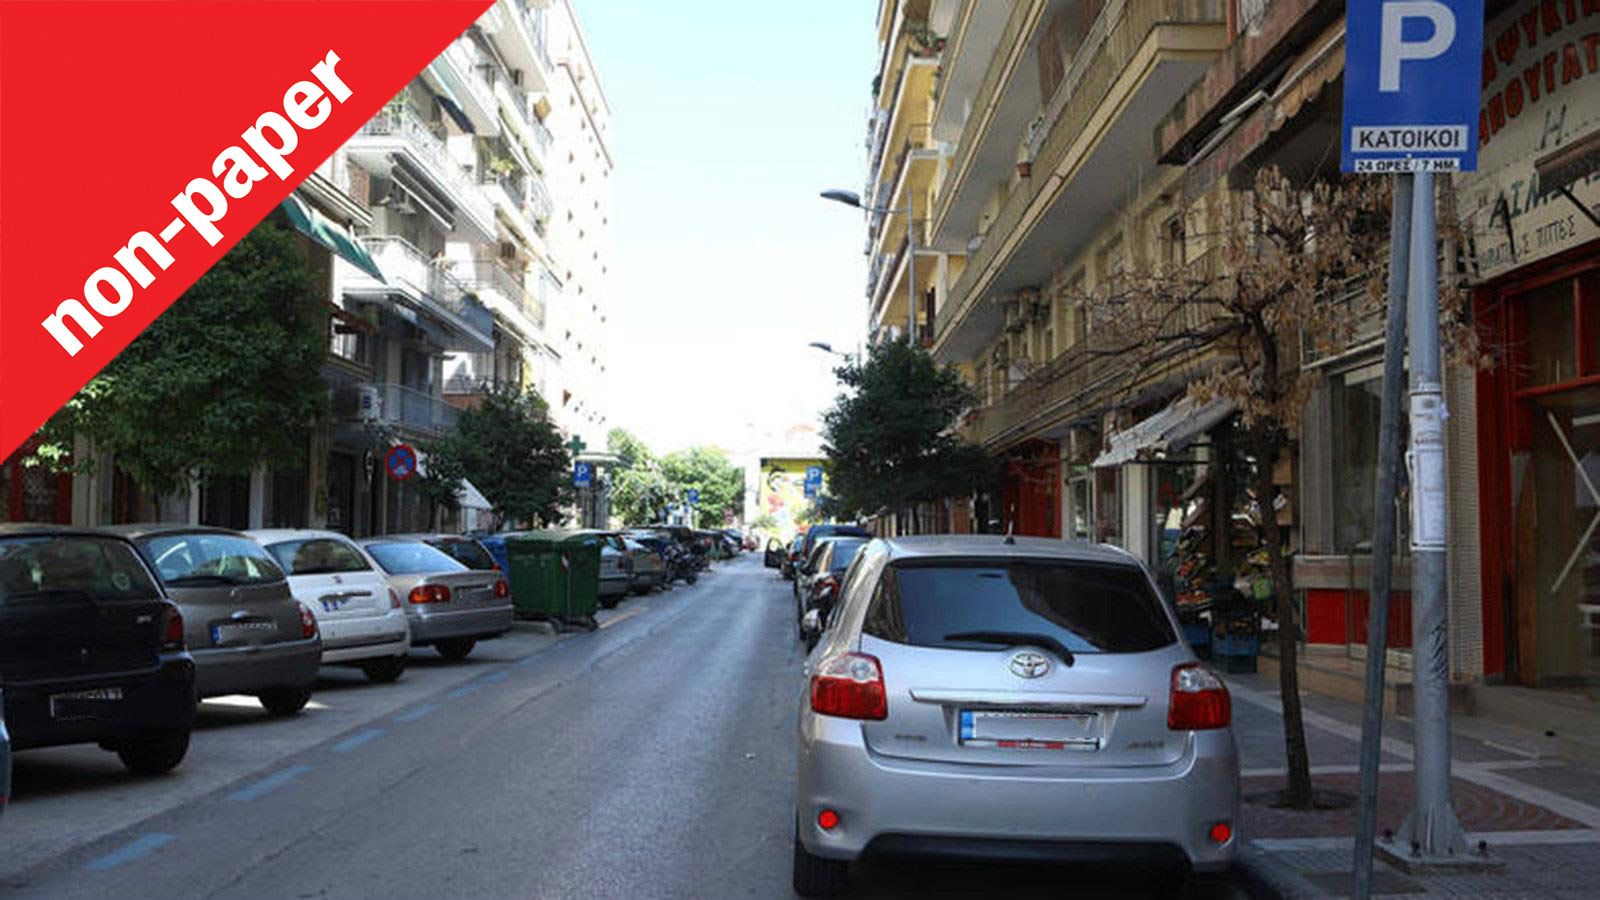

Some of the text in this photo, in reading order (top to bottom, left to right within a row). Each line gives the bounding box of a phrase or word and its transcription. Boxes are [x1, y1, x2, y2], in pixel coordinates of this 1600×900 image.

[1378, 1, 1457, 92] P
[1360, 129, 1459, 148] ΚΑΤΟΙΚΟΙ
[1358, 161, 1373, 171] 24
[1376, 161, 1411, 171] ΩΡΕΣ
[1423, 160, 1430, 170] 7
